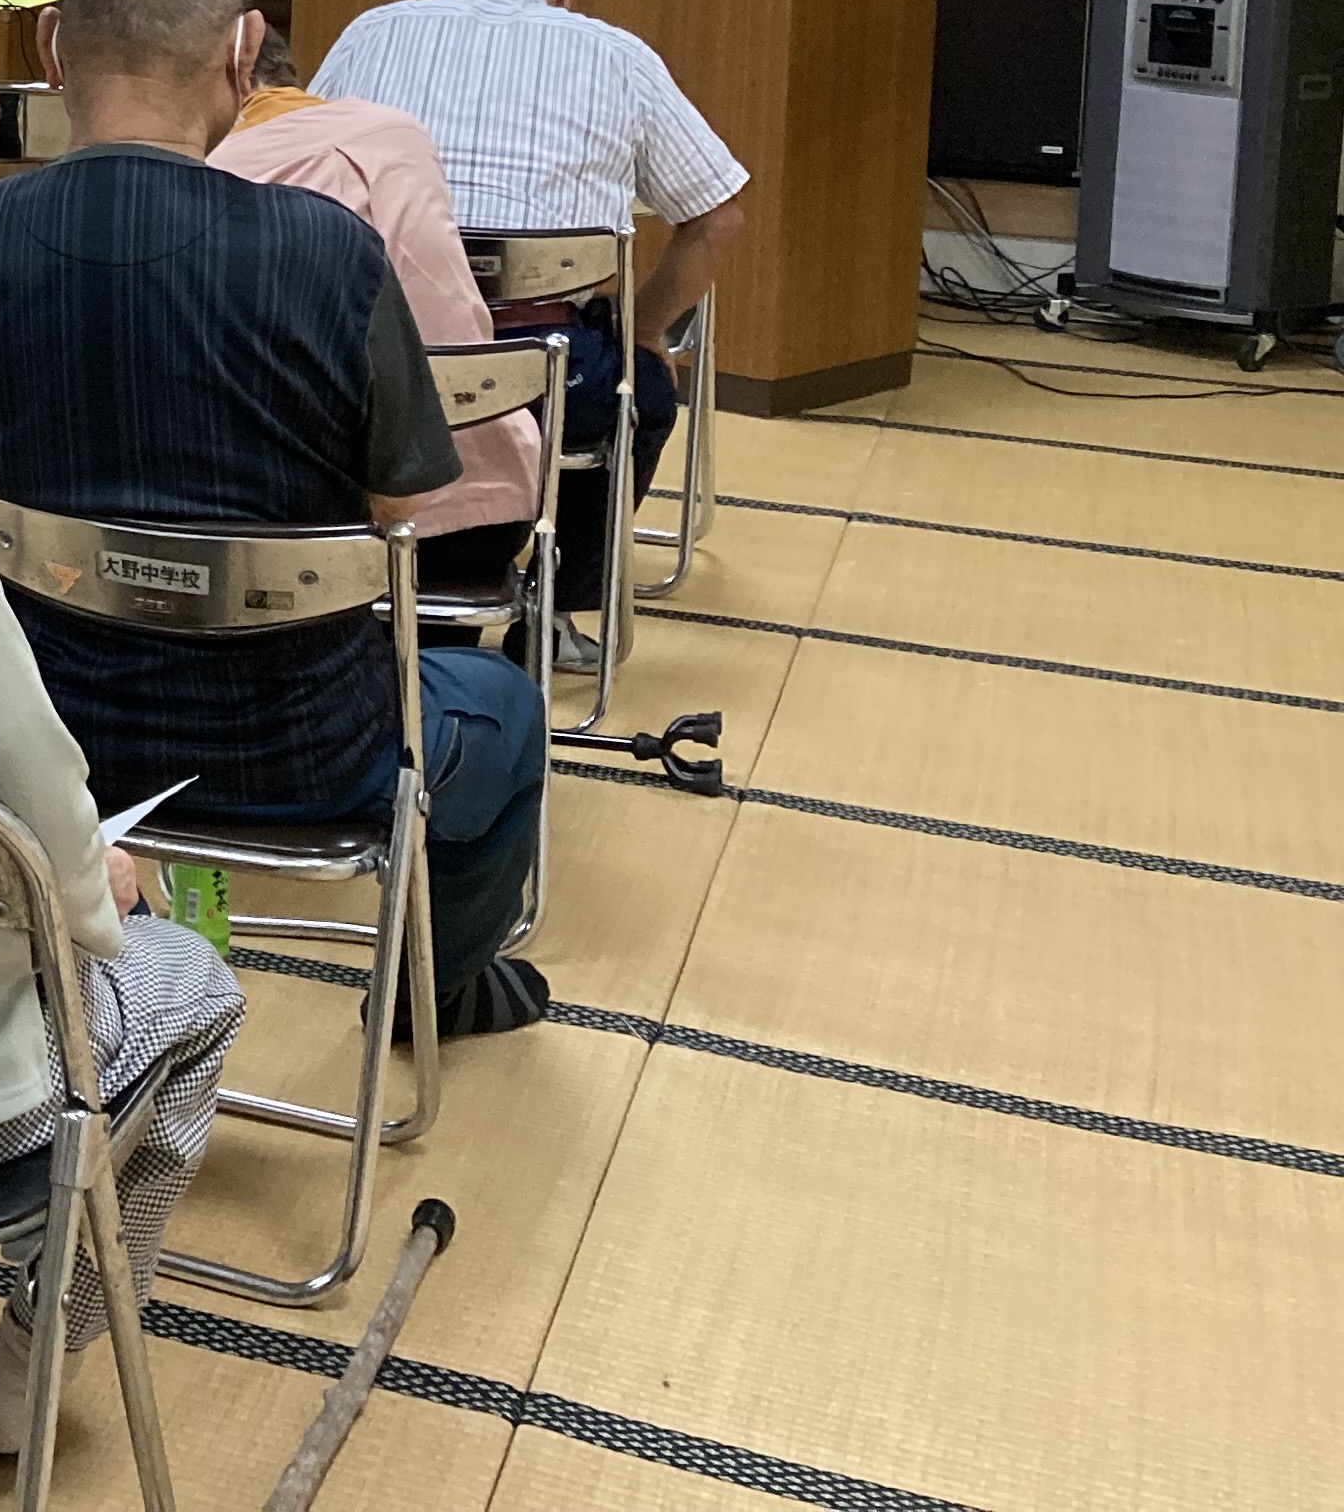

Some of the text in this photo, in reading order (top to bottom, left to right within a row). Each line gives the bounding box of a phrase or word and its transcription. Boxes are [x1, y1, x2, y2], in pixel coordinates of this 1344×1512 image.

[101, 557, 202, 590] 大野中学校
